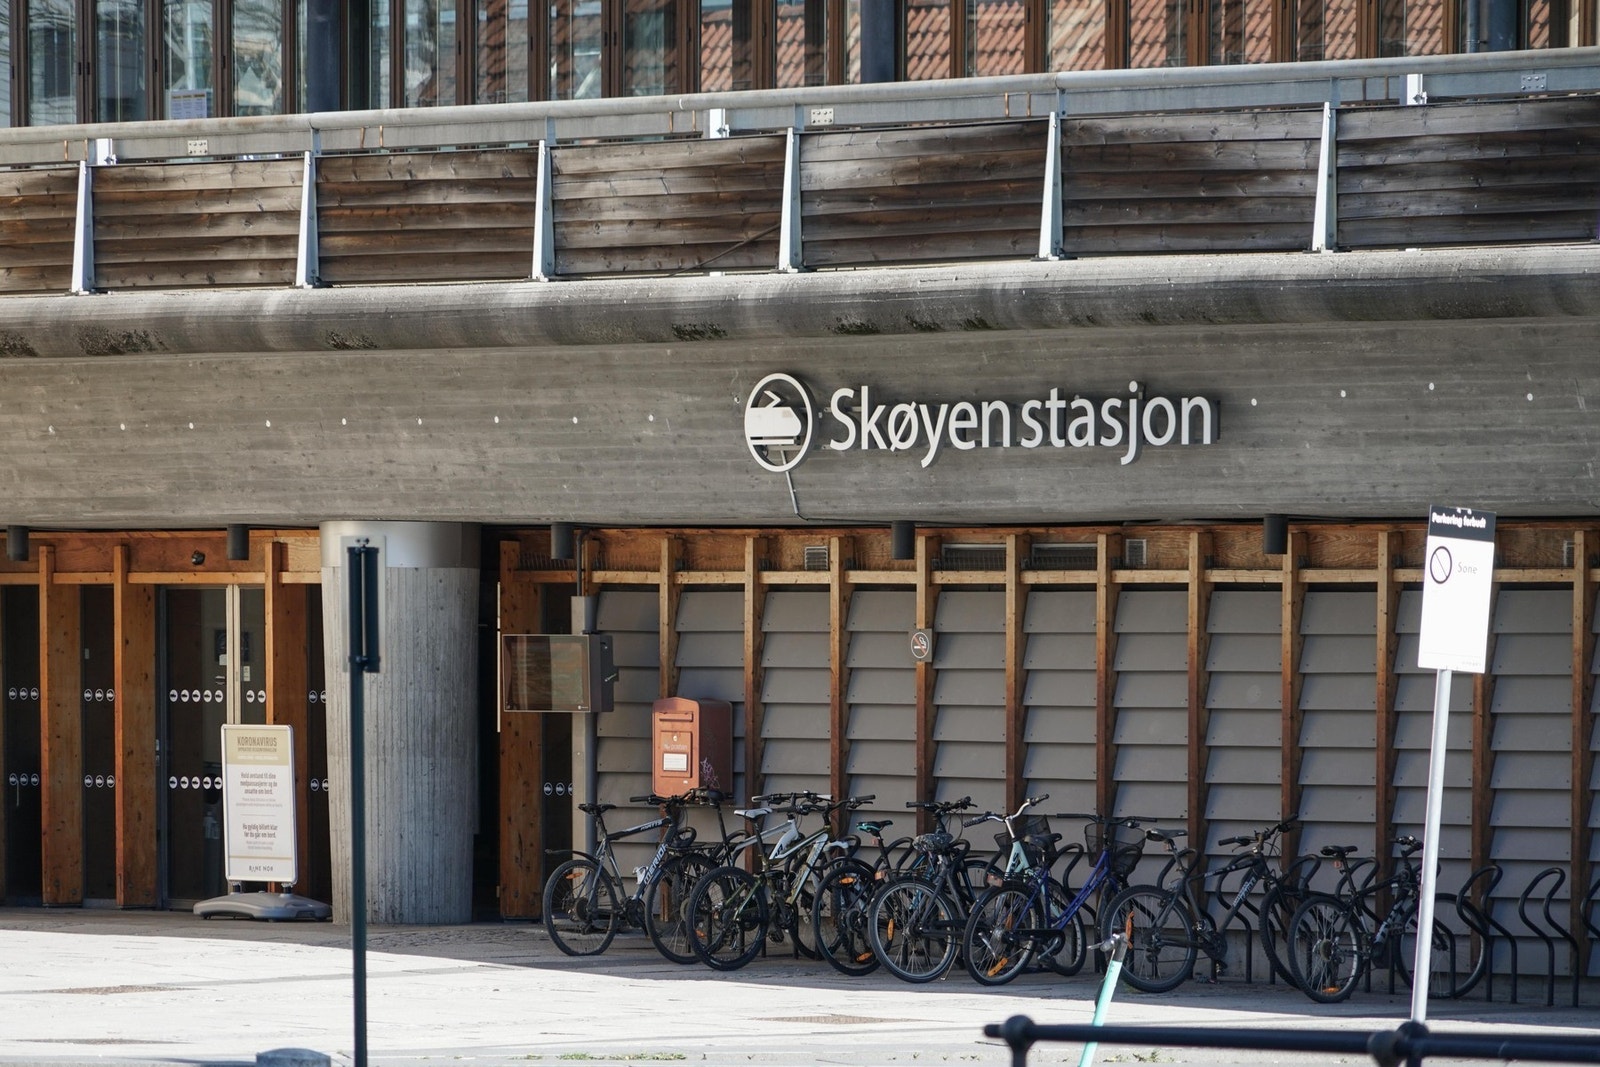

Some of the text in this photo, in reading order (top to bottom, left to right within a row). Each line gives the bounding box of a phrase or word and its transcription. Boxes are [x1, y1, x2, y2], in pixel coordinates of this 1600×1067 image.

[829, 380, 1213, 468] Skøyen stasjon
[1432, 512, 1486, 528] Parkering forbudt
[1457, 561, 1478, 575] Sone
[237, 736, 277, 747] KORONAVIRUS
